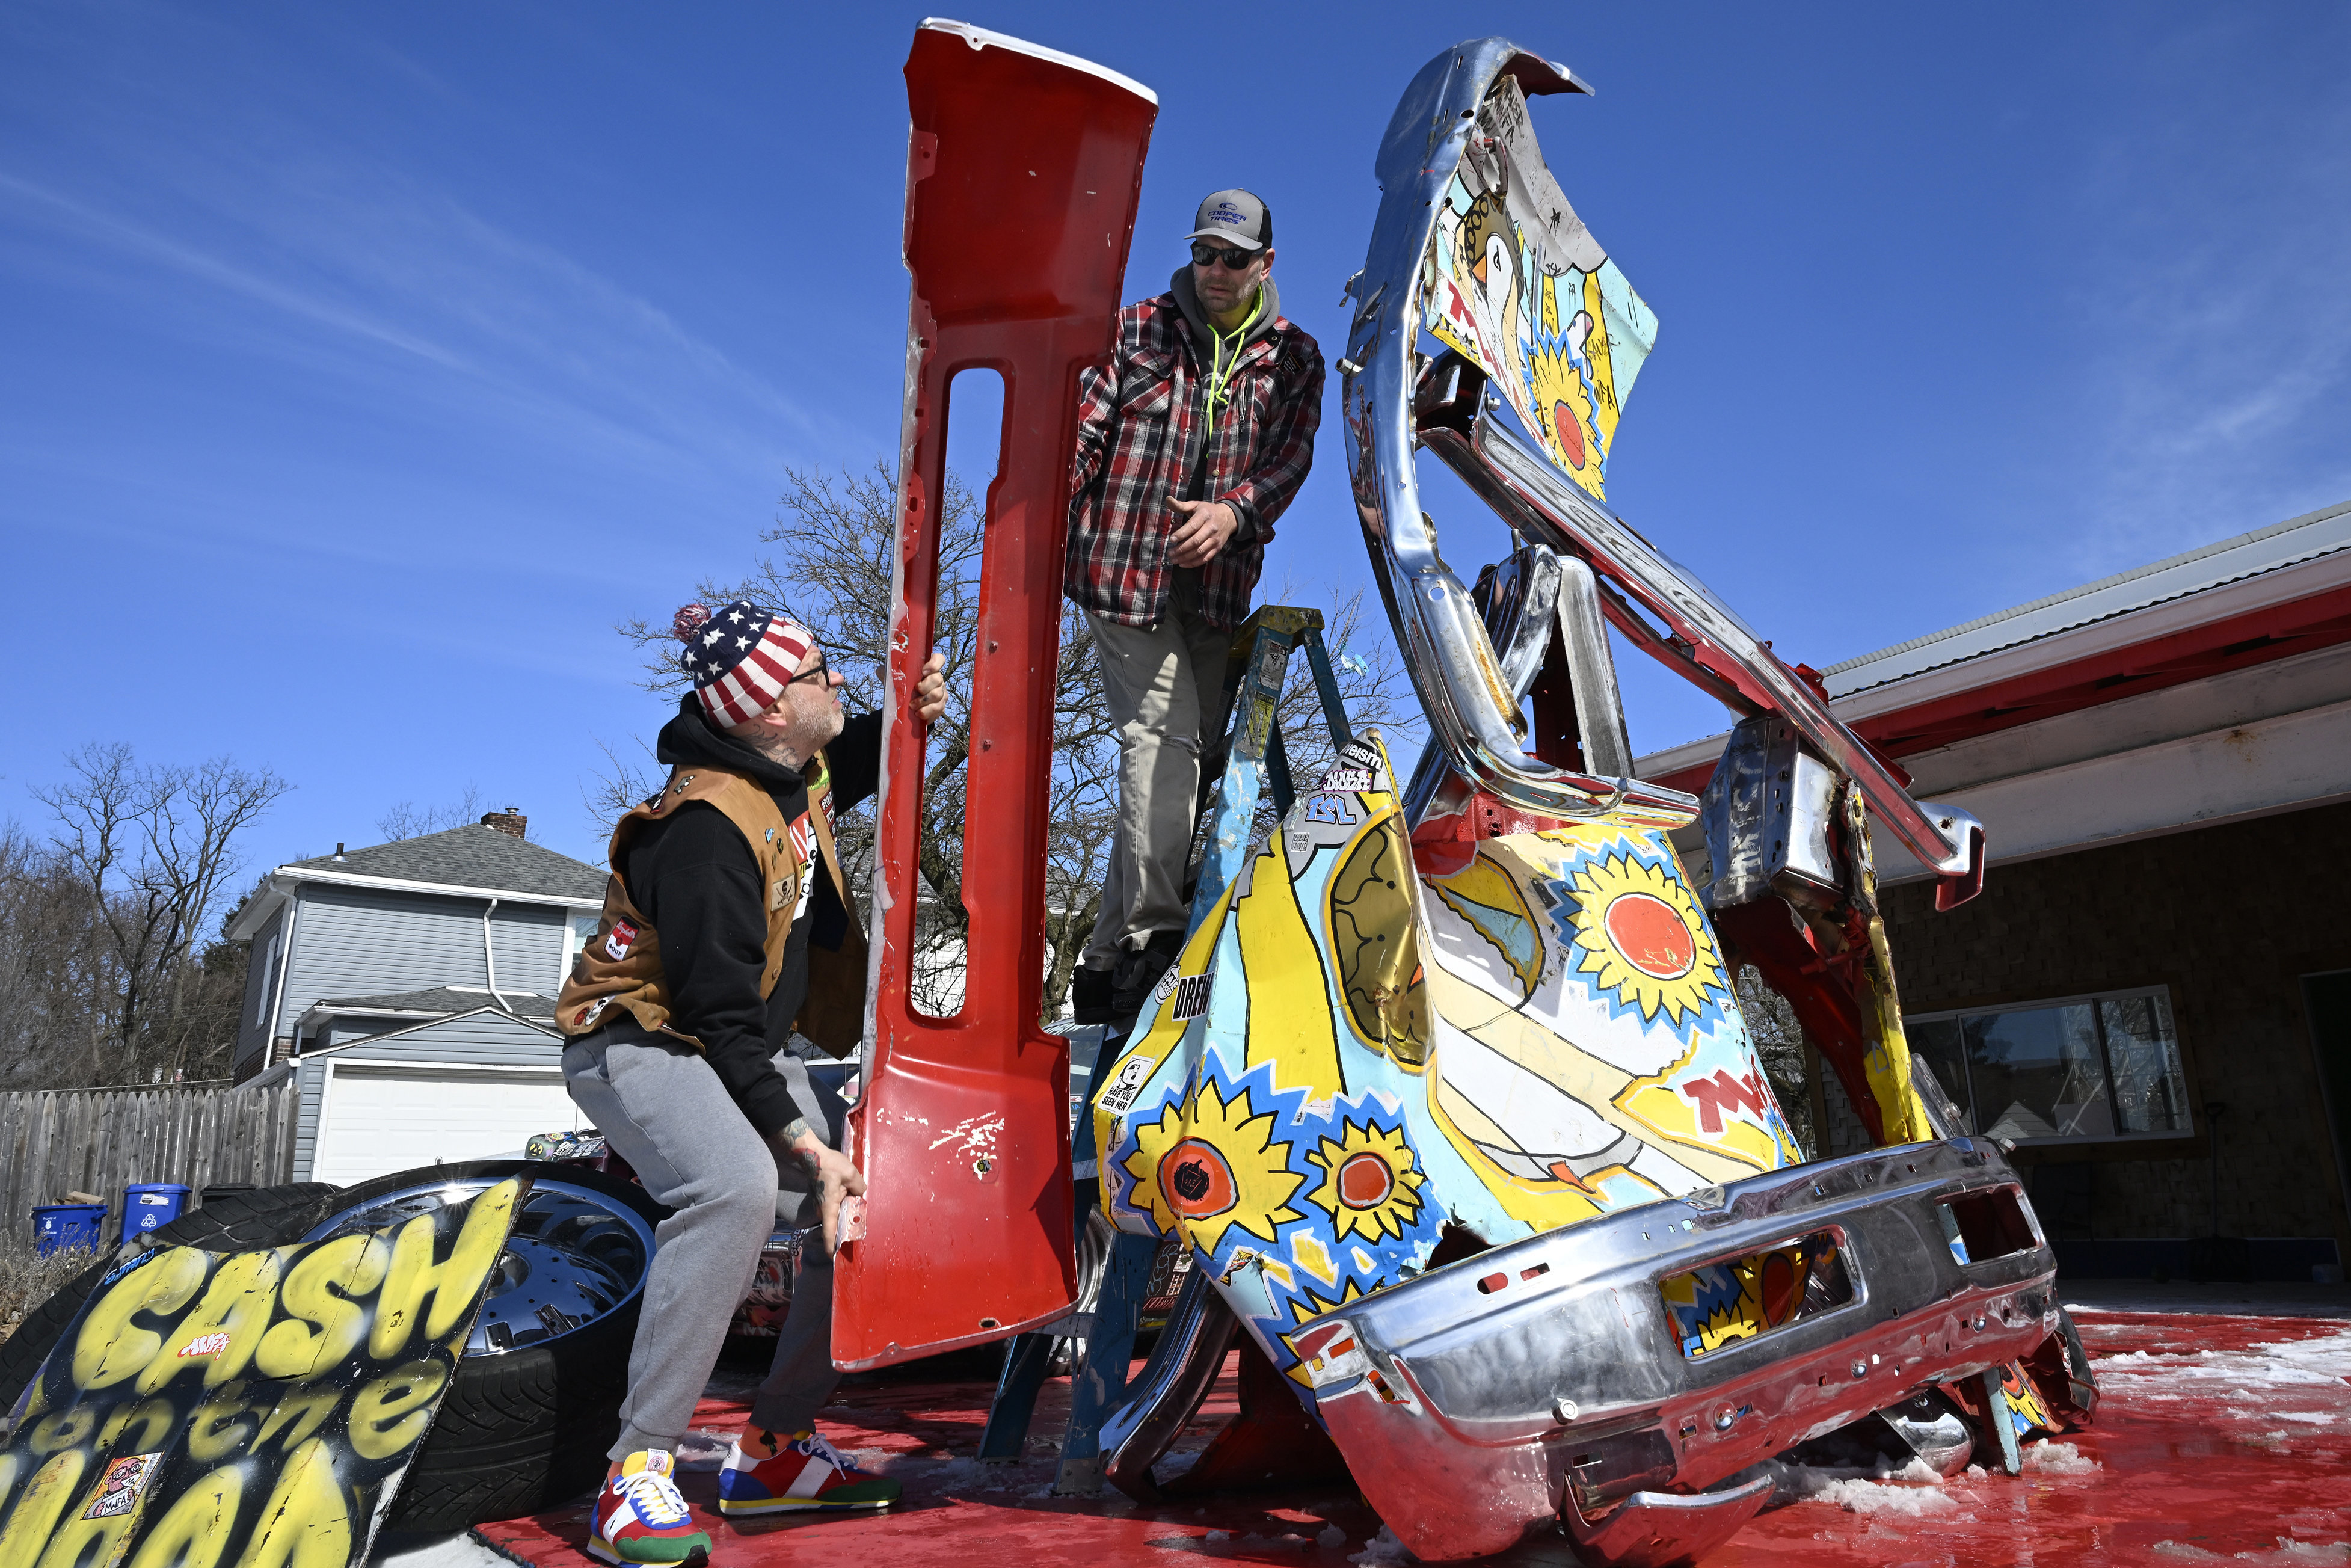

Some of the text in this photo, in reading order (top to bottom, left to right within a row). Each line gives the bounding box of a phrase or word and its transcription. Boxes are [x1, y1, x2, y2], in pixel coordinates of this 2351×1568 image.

[1207, 211, 1247, 222] COOPER
[1210, 216, 1241, 225] TIRES
[608, 943, 622, 956] SOUP
[1107, 1087, 1133, 1101] HAVE YOU
[1101, 1096, 1117, 1107] SEEN
[1114, 1100, 1128, 1111] HER
[73, 1179, 518, 1394] CASH
[104, 1495, 126, 1513] MWFA
